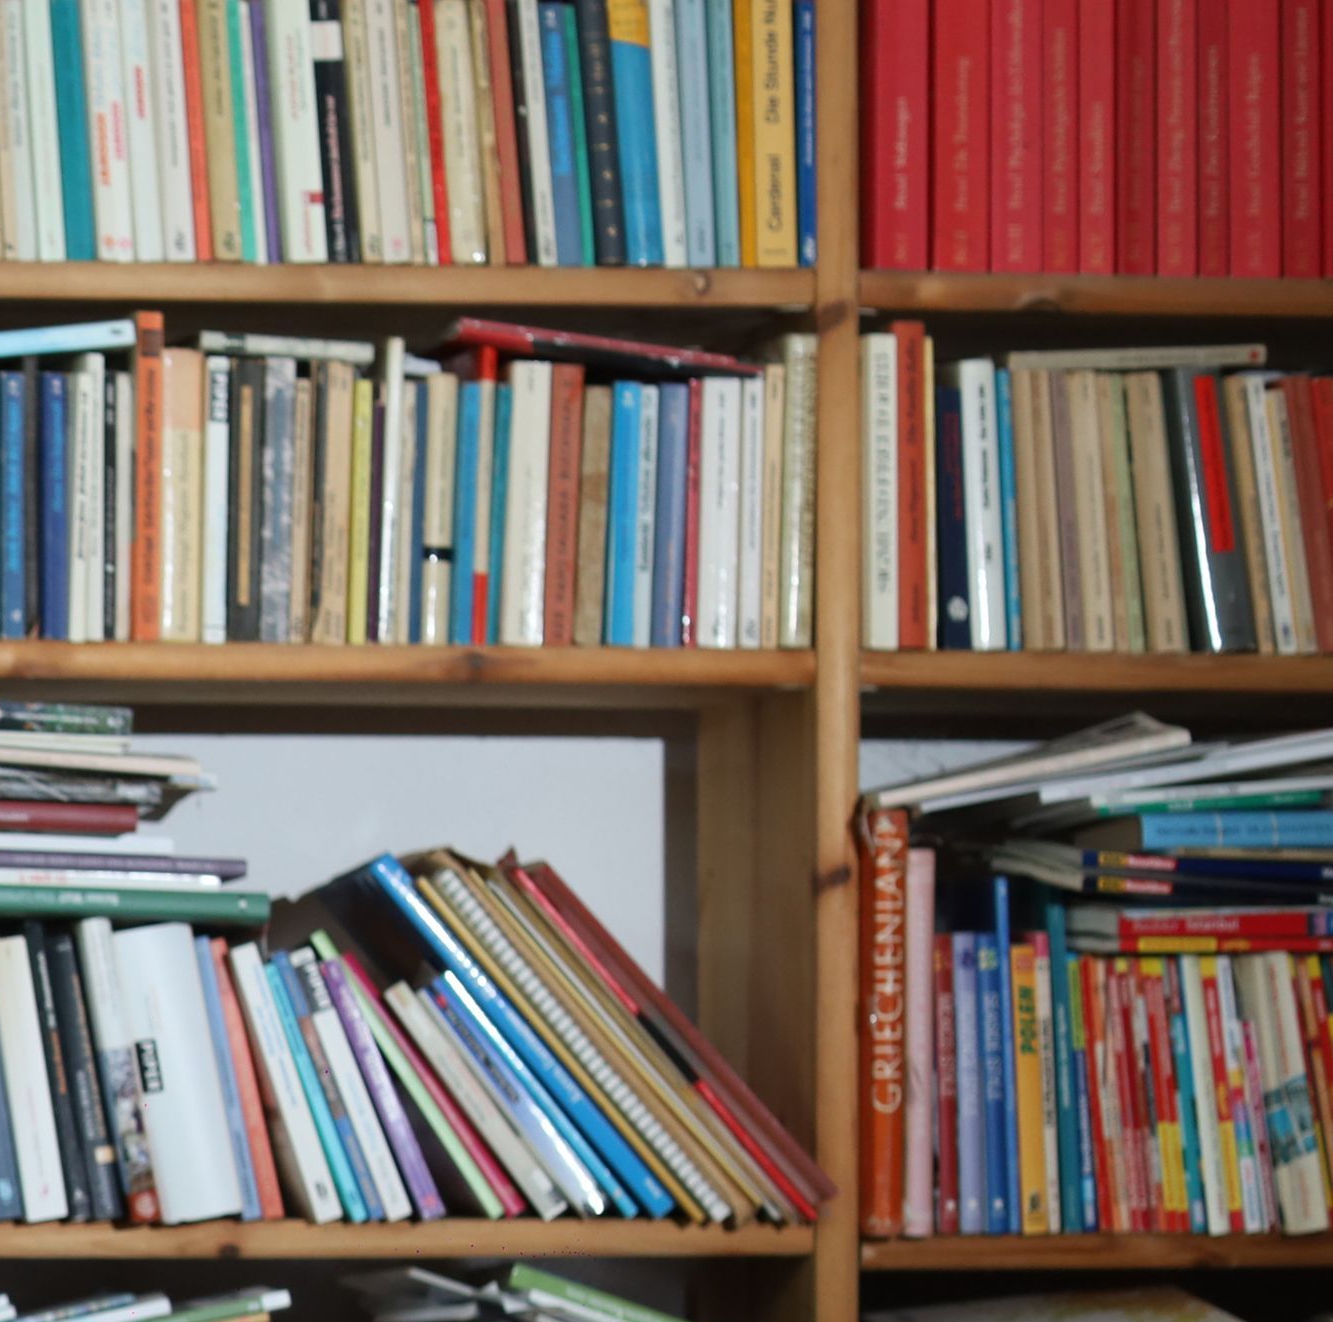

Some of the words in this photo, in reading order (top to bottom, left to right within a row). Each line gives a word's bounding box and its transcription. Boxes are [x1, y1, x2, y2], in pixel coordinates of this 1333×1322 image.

[764, 31, 779, 90] Stunde
[765, 96, 779, 124] Die
[767, 152, 782, 231] Cardenal
[1018, 985, 1035, 1054] POLEN
[138, 1042, 163, 1091] PIPER
